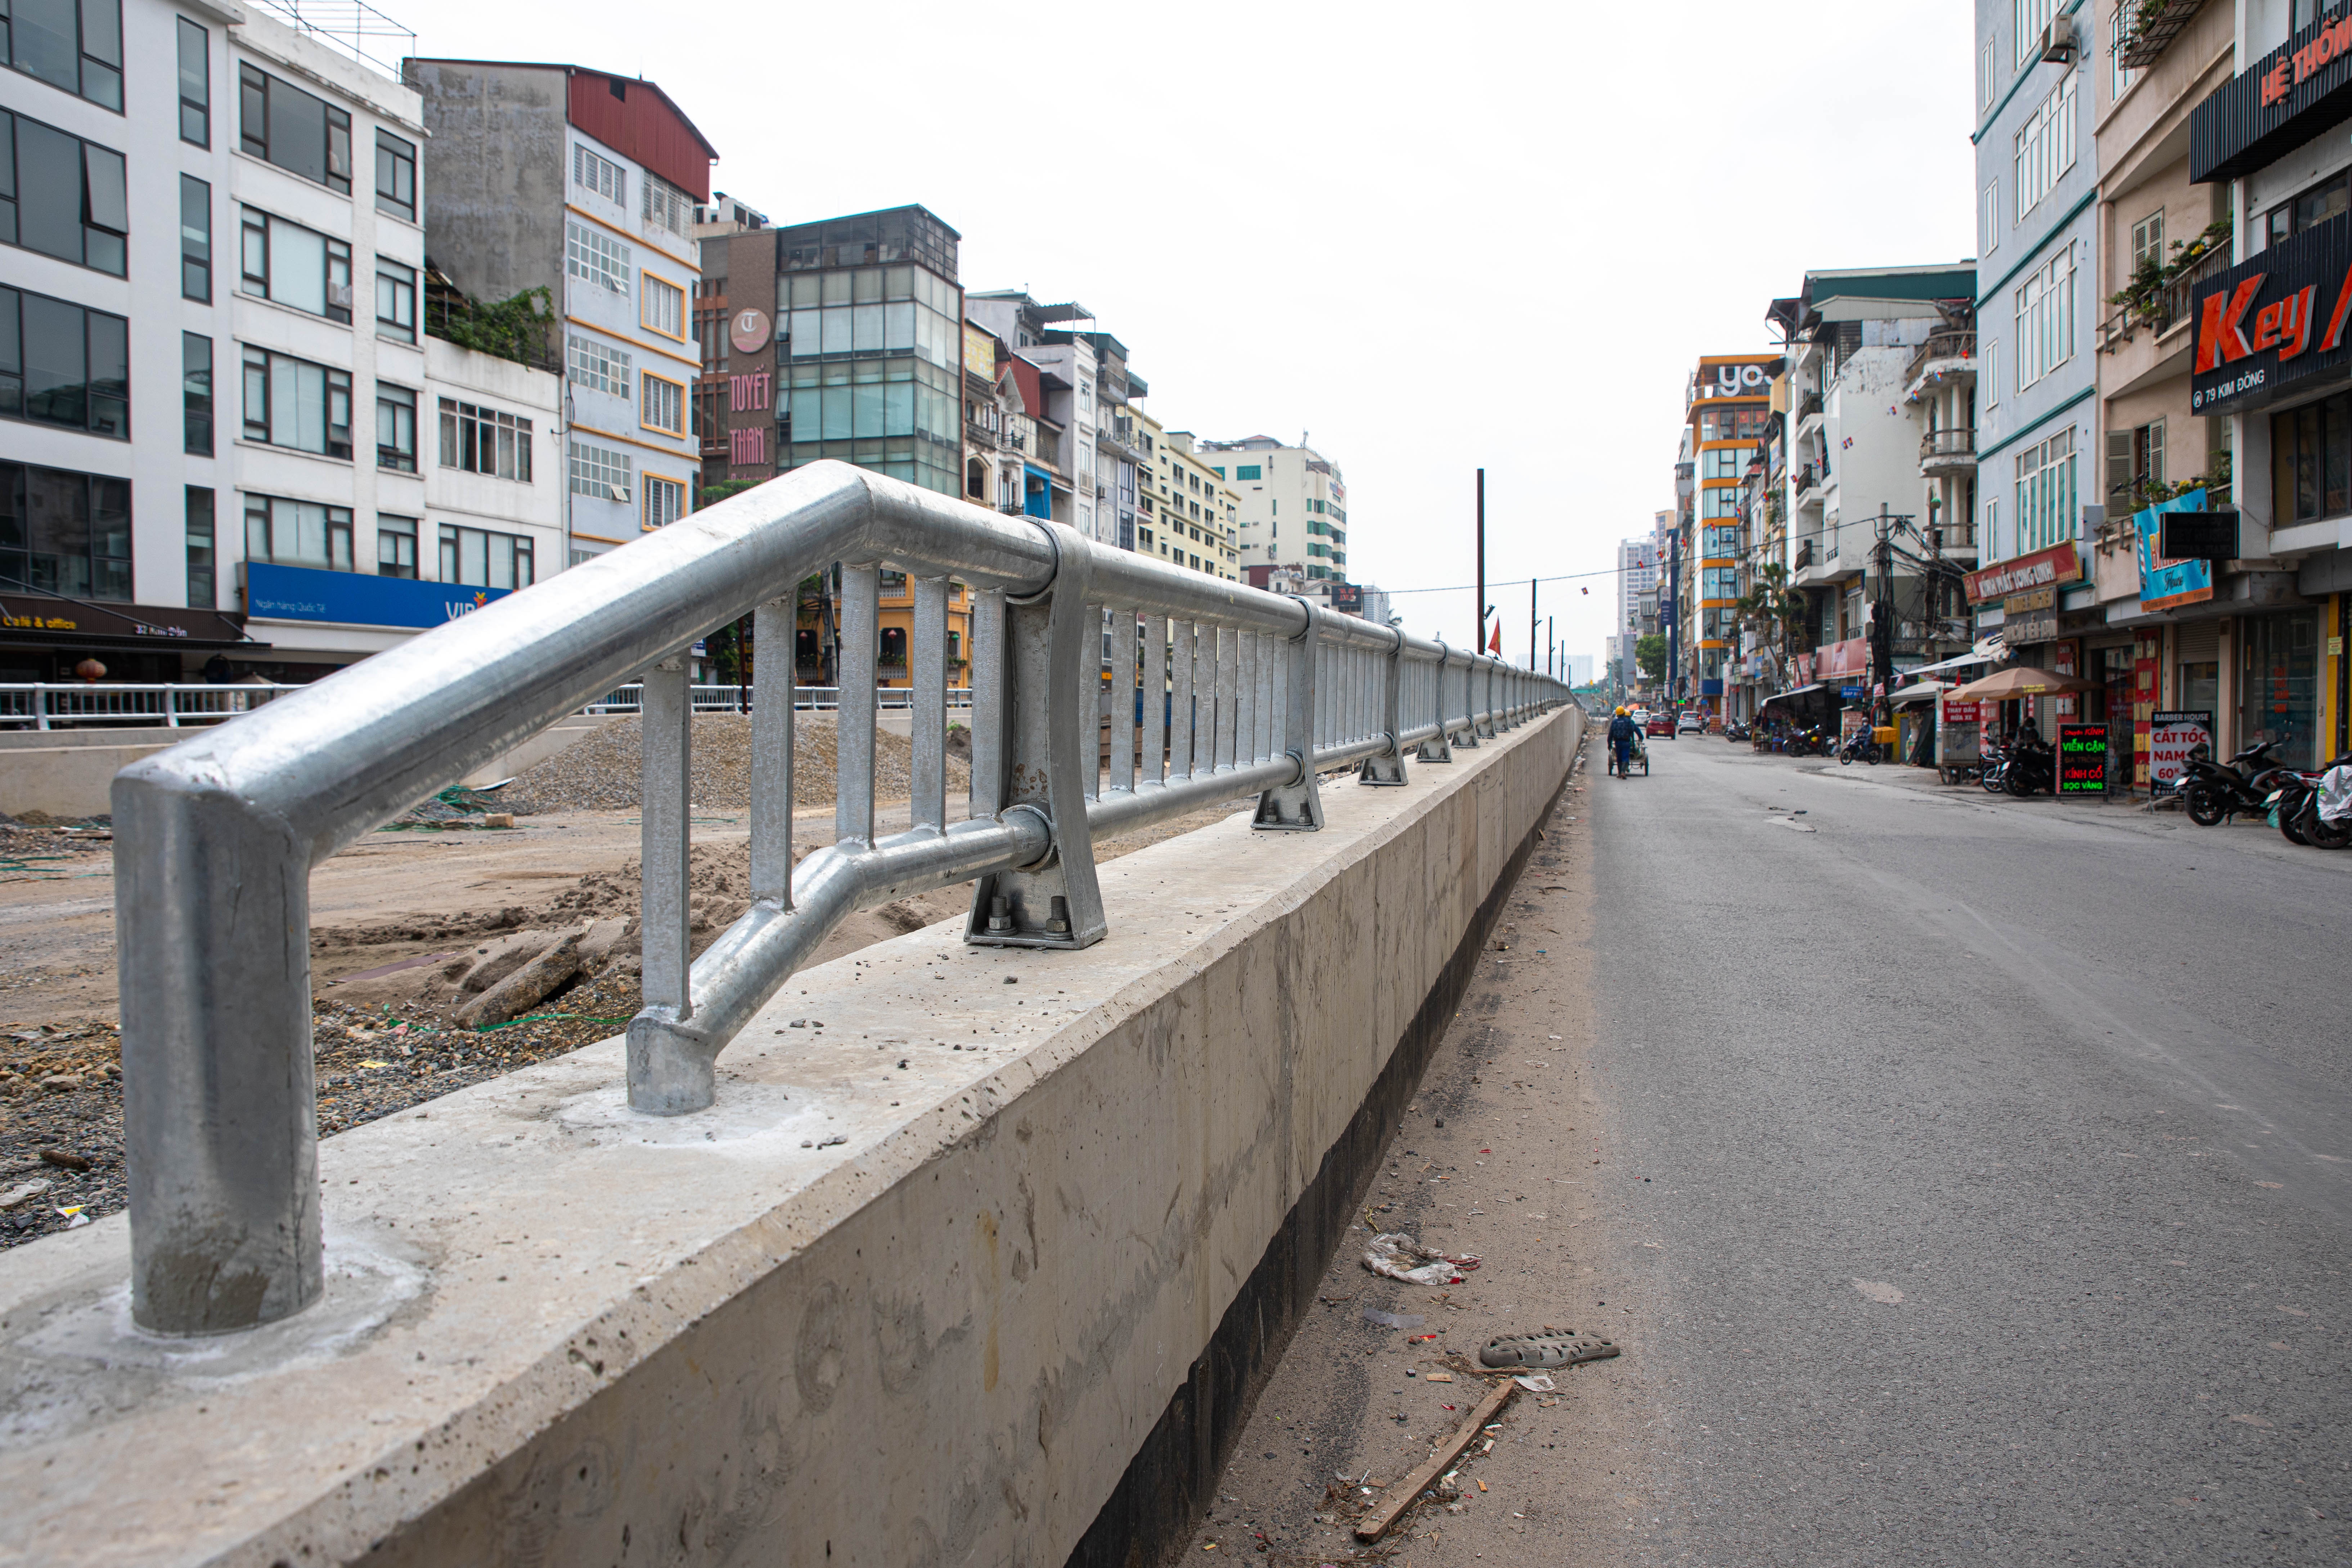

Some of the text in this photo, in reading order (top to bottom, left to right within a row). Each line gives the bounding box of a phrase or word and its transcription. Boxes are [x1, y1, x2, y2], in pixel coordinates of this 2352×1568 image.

[2261, 14, 2352, 108] HỆ THỐN
[2194, 272, 2317, 376] Key
[729, 363, 770, 412] TUYẾT
[2205, 369, 2265, 403] 79 KIM ĐỒNG
[34, 617, 44, 628] &
[2085, 727, 2105, 736] KÍNH
[2153, 724, 2178, 743] CẮT
[2180, 727, 2207, 743] TÓC
[2085, 740, 2105, 753] CẬN
[2154, 750, 2185, 761] NAM
[2065, 767, 2087, 779] KÍNH
[2063, 780, 2103, 791] BỌC VÀNG
